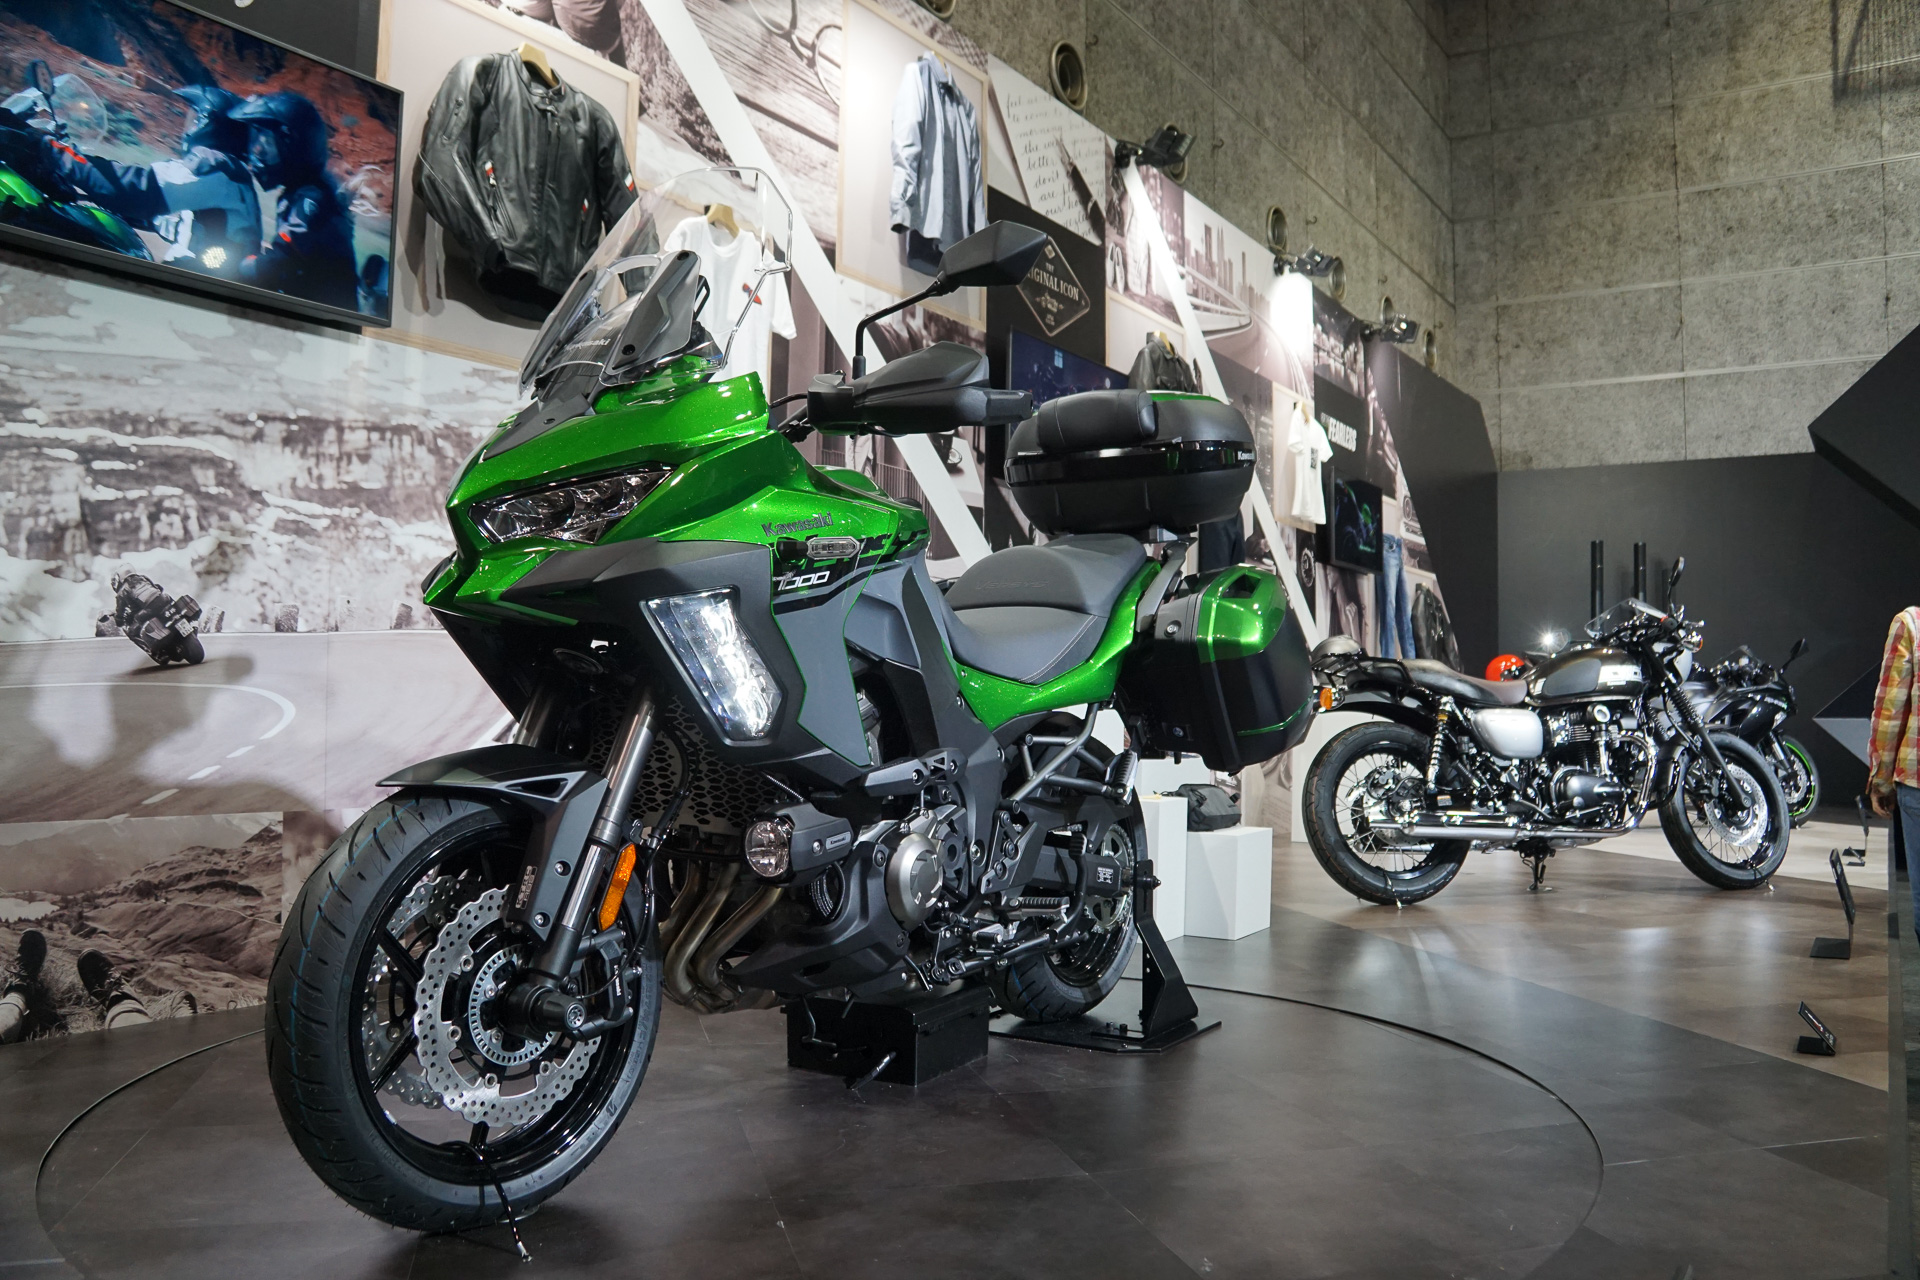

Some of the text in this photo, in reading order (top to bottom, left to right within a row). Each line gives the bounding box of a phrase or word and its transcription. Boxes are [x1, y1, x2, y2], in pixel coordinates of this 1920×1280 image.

[1027, 266, 1079, 301] IGINAL ICON
[1328, 416, 1357, 452] FEARLESS
[761, 511, 834, 537] Kawasaki
[778, 572, 831, 591] 1000
